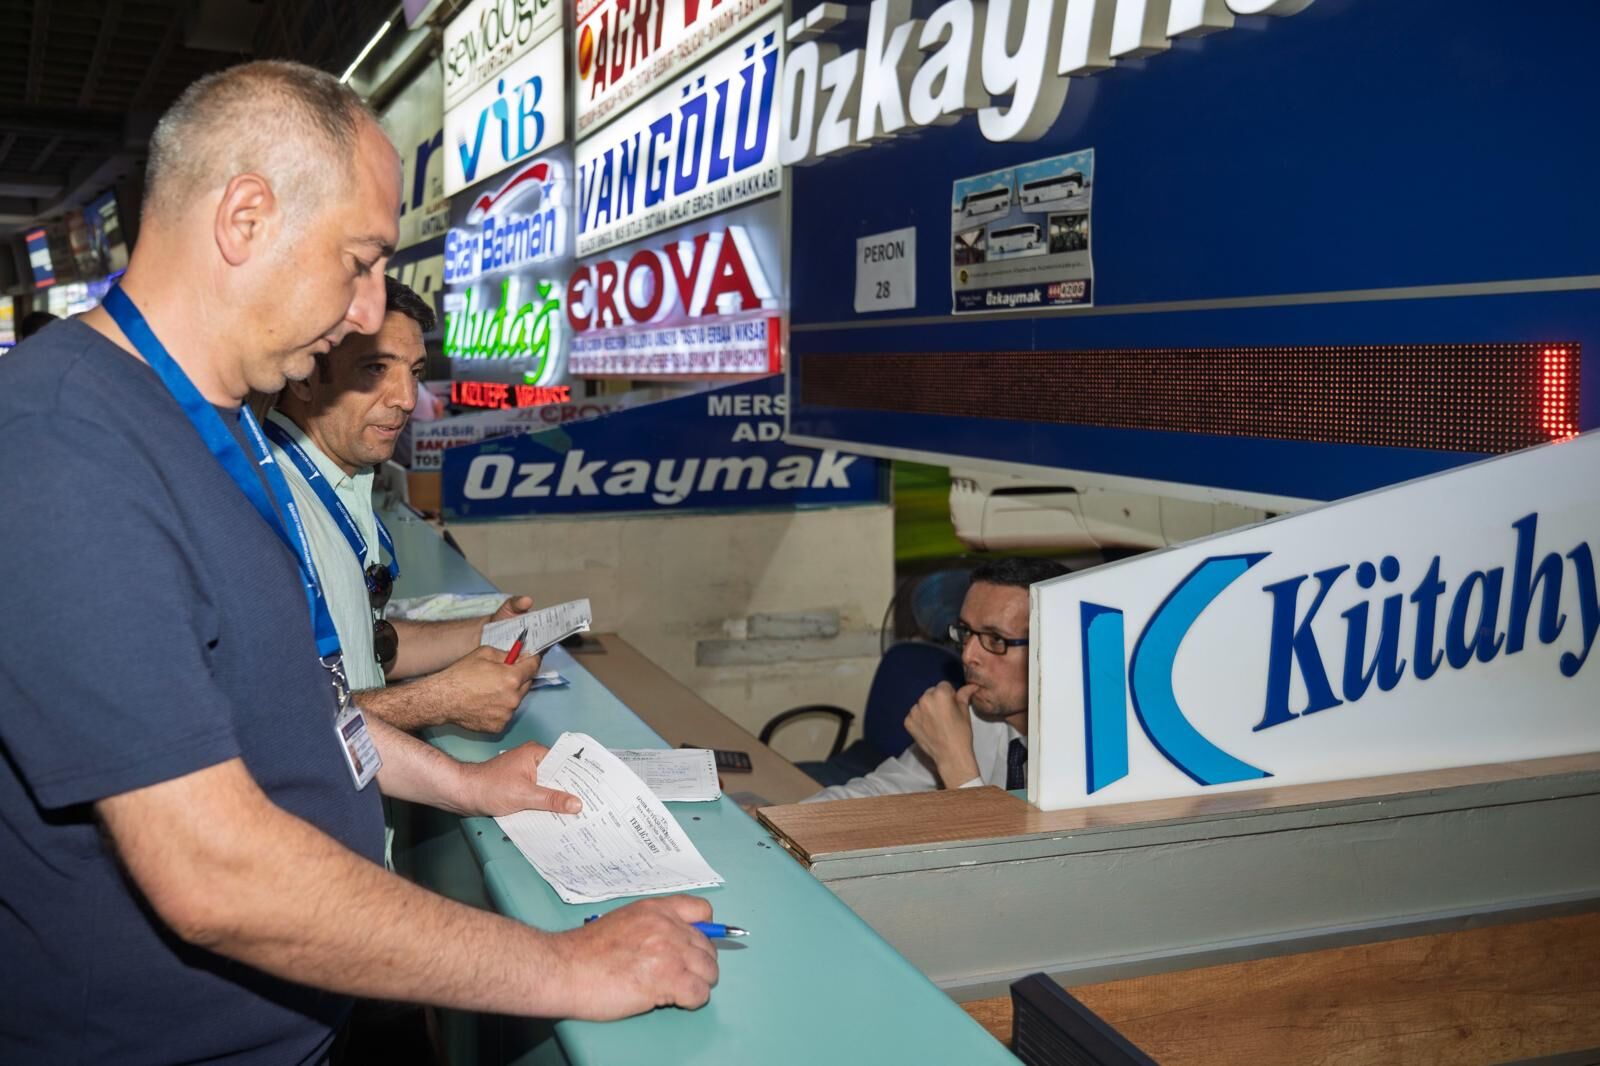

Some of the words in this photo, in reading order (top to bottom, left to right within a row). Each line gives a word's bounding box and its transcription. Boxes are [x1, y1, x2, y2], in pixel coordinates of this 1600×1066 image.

[863, 240, 905, 264] PERON
[567, 226, 760, 332] EROVA
[875, 281, 891, 300] 28
[731, 421, 787, 442] AD
